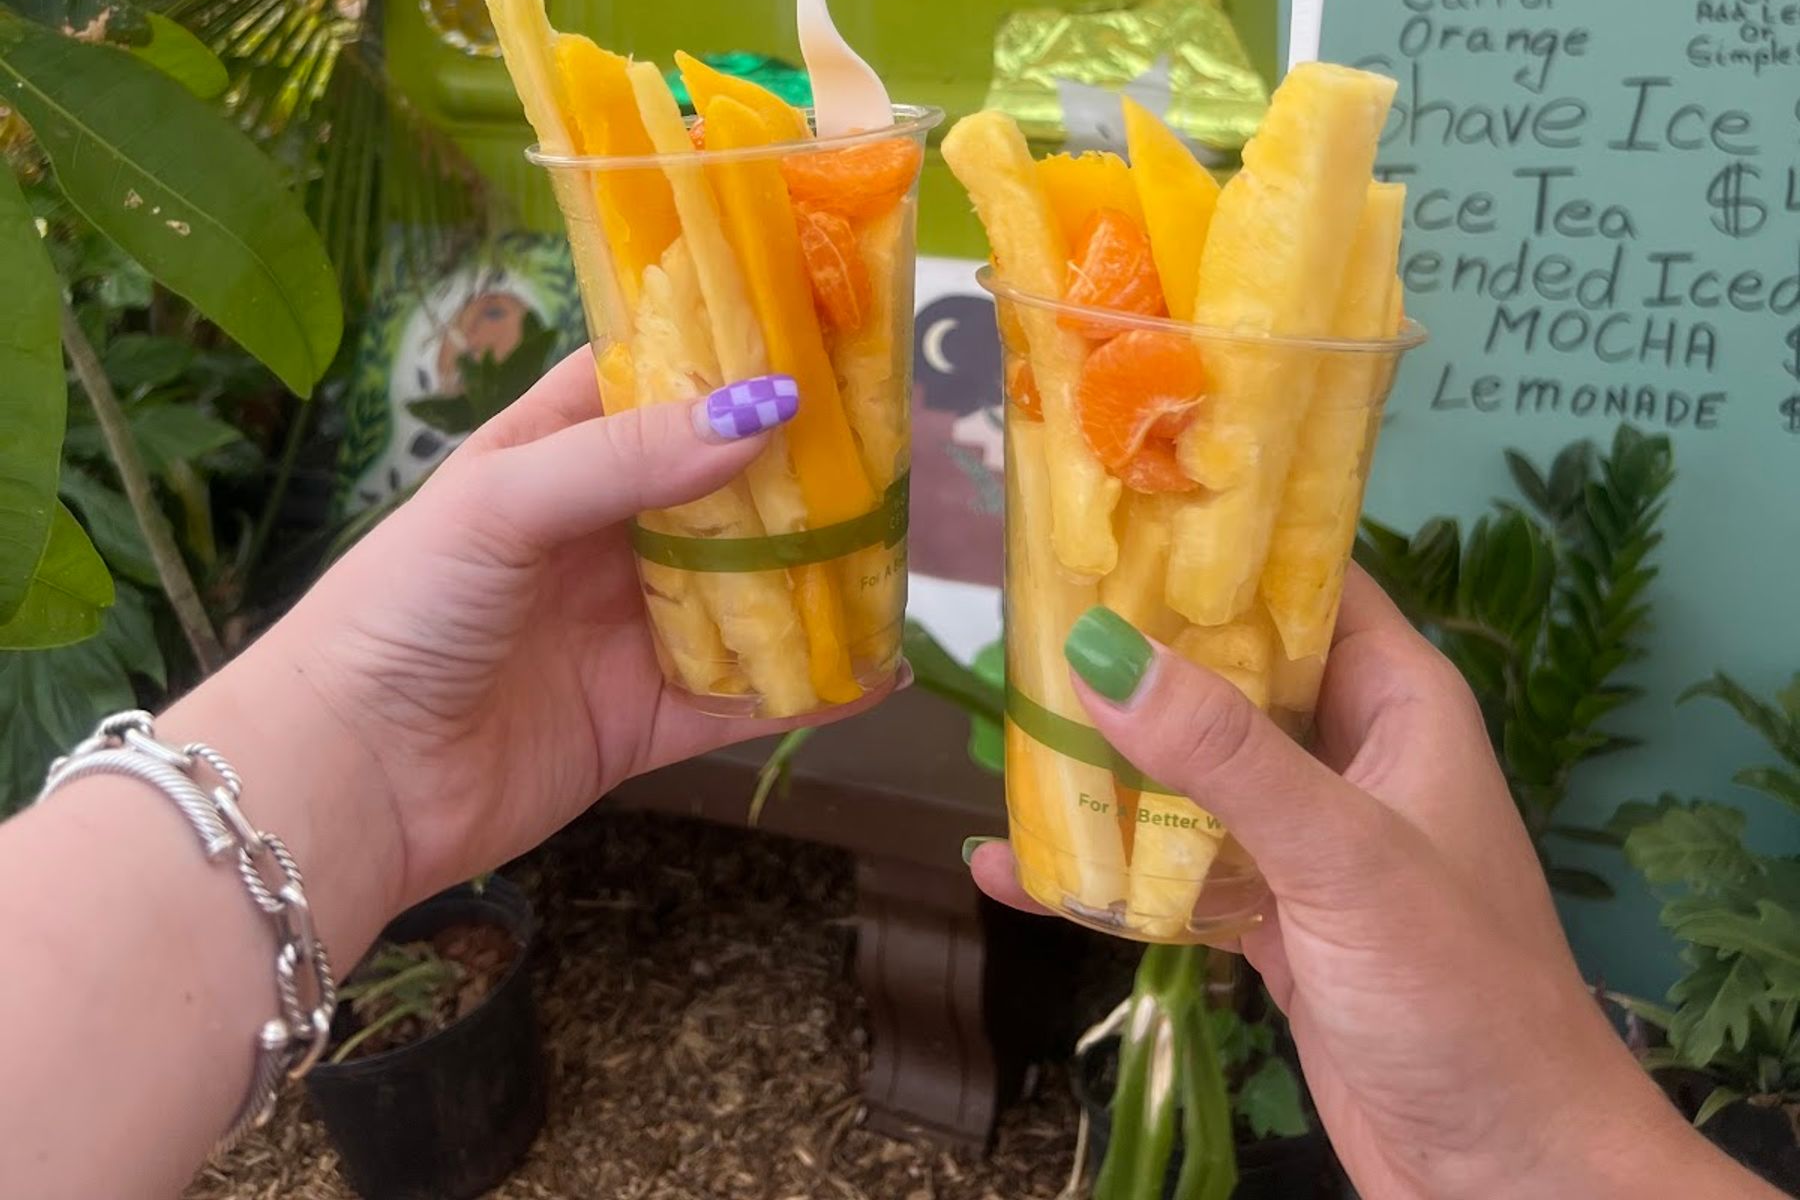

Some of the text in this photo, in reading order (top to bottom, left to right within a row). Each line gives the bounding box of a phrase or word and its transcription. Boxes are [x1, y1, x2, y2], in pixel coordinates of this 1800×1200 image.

[1399, 14, 1591, 94] Orange
[1607, 75, 1762, 156] Ice
[1512, 166, 1638, 241] Tea
[1396, 238, 1625, 311] ended
[1484, 304, 1717, 373] MOCHA
[1078, 792, 1109, 815] For
[1136, 807, 1200, 830] Better
